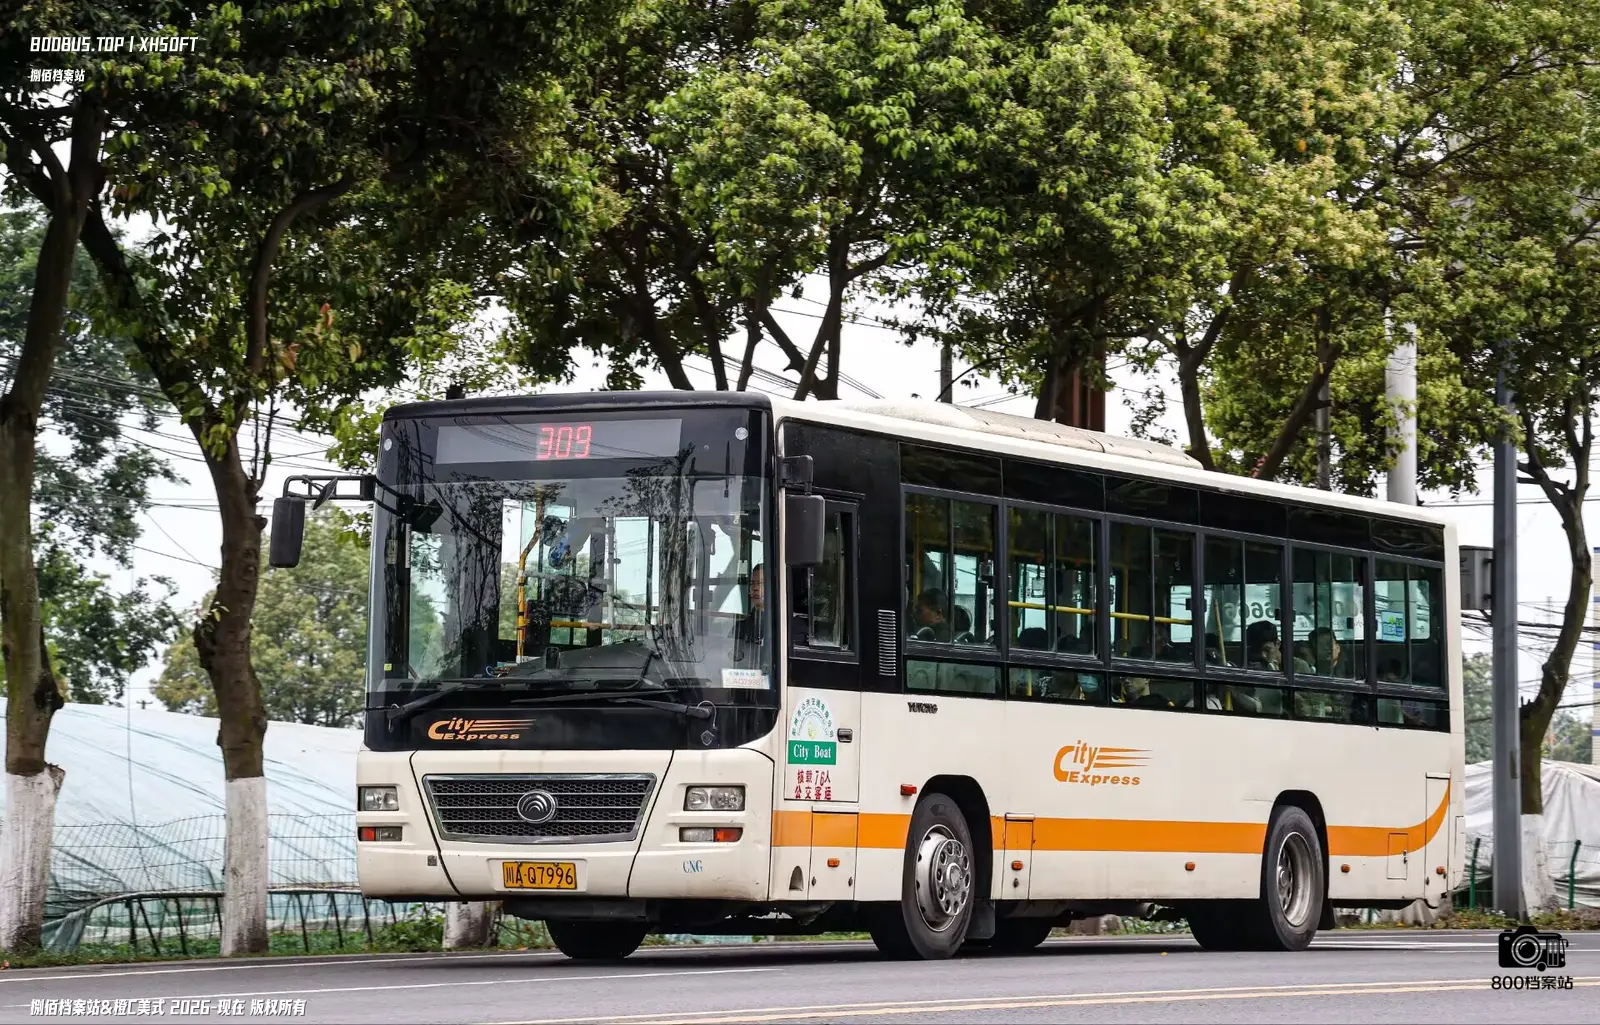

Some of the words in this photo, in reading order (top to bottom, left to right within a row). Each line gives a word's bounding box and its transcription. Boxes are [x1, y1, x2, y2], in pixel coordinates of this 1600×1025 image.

[537, 425, 592, 460] 309
[428, 718, 475, 740] City
[443, 733, 520, 741] Express
[793, 744, 809, 760] City
[814, 745, 832, 759] Boat
[1053, 740, 1098, 782] City
[1068, 771, 1141, 786] Express
[795, 785, 832, 800] 公交客运
[683, 860, 703, 873] CNG
